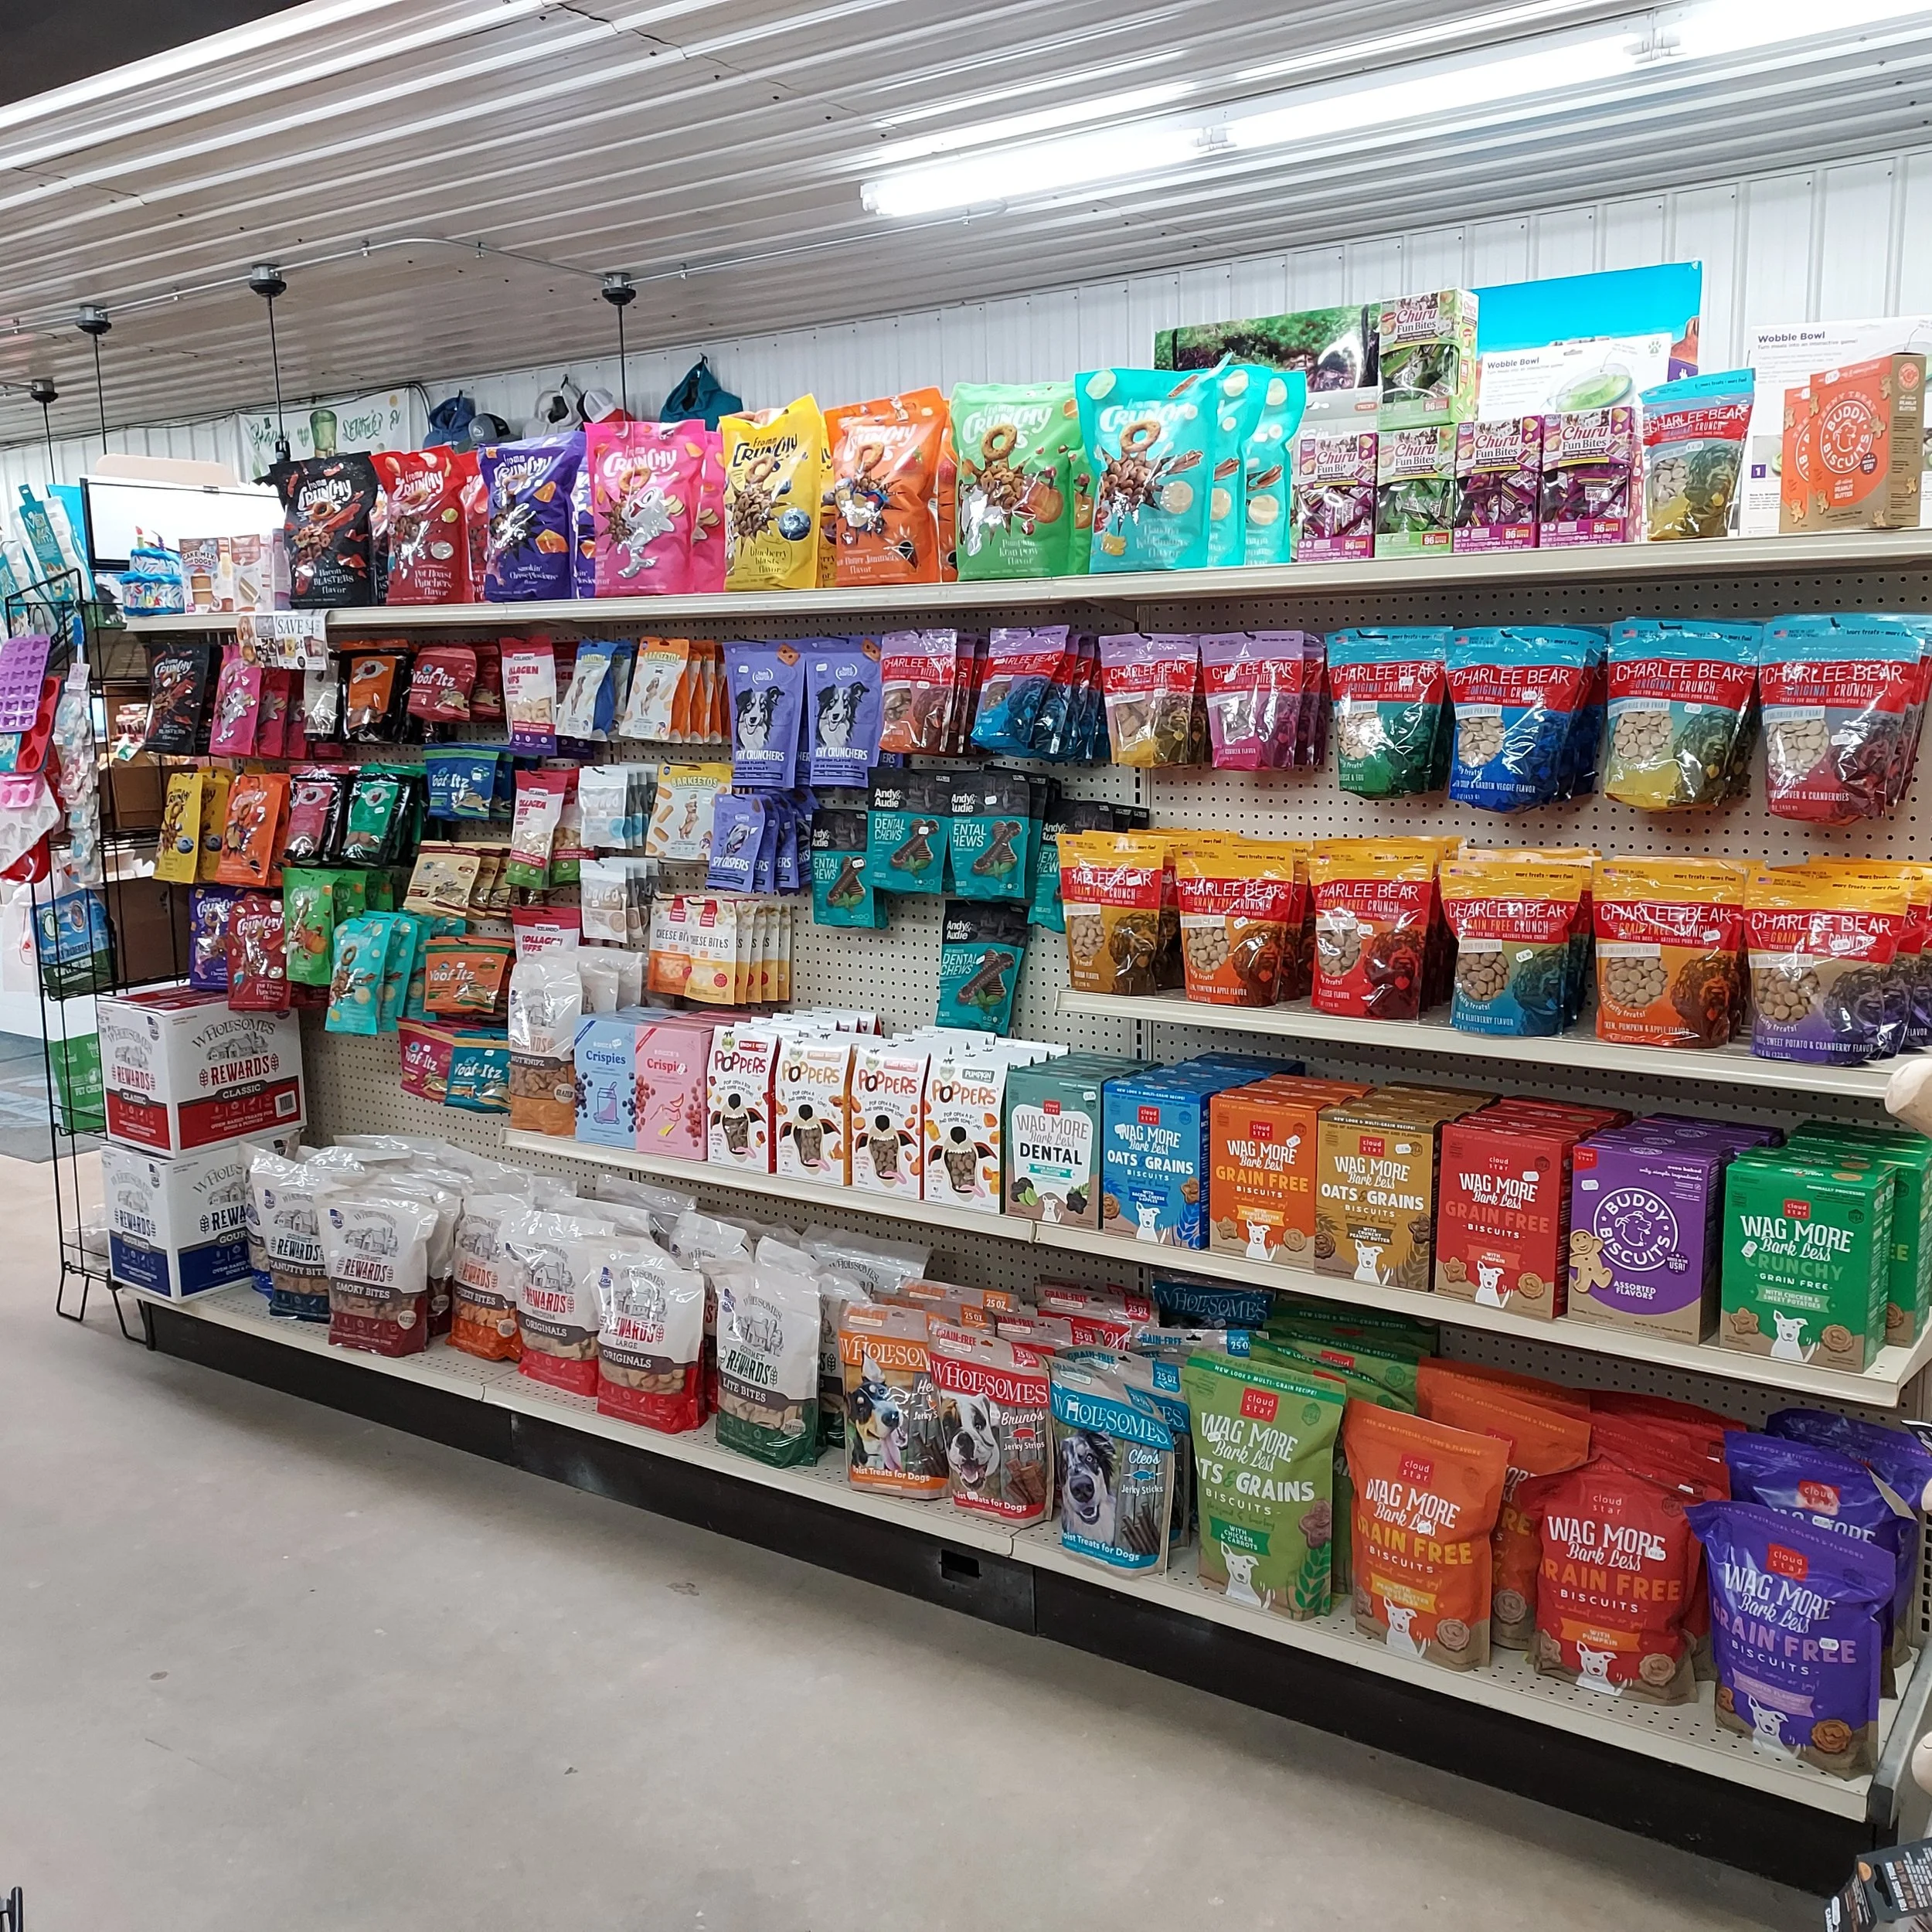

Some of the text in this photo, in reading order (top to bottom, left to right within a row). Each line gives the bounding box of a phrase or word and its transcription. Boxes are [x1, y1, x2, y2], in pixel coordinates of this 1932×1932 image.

[1396, 308, 1437, 324] Churu
[1397, 320, 1436, 333] Fun Bites
[1758, 332, 1825, 342] Wobble Bowl
[1488, 359, 1516, 369] Wobble
[1708, 406, 1745, 421] BEAR
[1828, 406, 1866, 430] BUDDY
[1562, 427, 1607, 440] Churu
[1396, 443, 1437, 457] Churu
[1563, 437, 1607, 448] Fun Bites
[733, 434, 798, 468] CRUNCHY
[1823, 434, 1869, 468] BISCUITS
[1395, 454, 1435, 467] Fun Bites
[1423, 535, 1435, 545] 96
[182, 552, 199, 560] CAKE
[314, 576, 354, 585] BLASTERS
[277, 619, 303, 634] SAVE
[1158, 662, 1186, 675] BEAR
[1616, 662, 1743, 685] CHARLEE BEAR
[1853, 665, 1903, 684] BEAR
[1453, 668, 1569, 687] CHARLEE BEAR
[1471, 685, 1505, 696] ORIGINAL
[1636, 679, 1715, 694] ORIGINAL CRUNCH
[1835, 684, 1873, 697] CRUNCH
[745, 749, 784, 762] CRUNCHERS
[828, 748, 867, 760] CRUNCHERS
[672, 777, 716, 787] BARKEETOS
[1476, 781, 1536, 793] GARDEN VEGGIE FLAVOR
[875, 798, 899, 808] Audie
[1809, 792, 1849, 801] CRANBERRIES
[875, 818, 905, 831] DENTAL
[875, 829, 902, 840] CHEWS
[1377, 883, 1419, 902] BEAR
[1348, 900, 1399, 913] FREE CRUNCH
[1685, 906, 1732, 923] BEAR
[1491, 920, 1549, 934] FREE CRUNCH
[1841, 915, 1892, 936] BEAR
[708, 936, 729, 949] BITES
[947, 930, 968, 940] Audie
[1770, 932, 1796, 944] GRAIN
[942, 954, 977, 966] DENTAL
[940, 964, 973, 975] CHEWS
[1495, 1017, 1513, 1026] FLAVOR
[1767, 1038, 1874, 1053] SWEET POTATO & CRANBERRY FLAVOR
[586, 1050, 626, 1065] Crispies
[715, 1052, 767, 1073] POPPERS
[117, 1066, 150, 1090] REWARDS
[210, 1056, 270, 1085] REWARDS
[782, 1062, 840, 1083] POPPERS
[859, 1069, 919, 1094] POPPERS
[123, 1092, 146, 1104] CLASSIC
[223, 1083, 260, 1099] CLASSIC
[933, 1080, 996, 1104] POPPERS
[1016, 1114, 1088, 1141] WAG MORE
[1029, 1132, 1075, 1148] Bark Less
[1147, 1128, 1181, 1148] MORE
[1020, 1144, 1082, 1164] DENTAL
[1129, 1139, 1169, 1155] Bark Less
[1227, 1140, 1297, 1165] WAG MORE
[1107, 1150, 1194, 1175] OATS GRAINS
[1240, 1155, 1283, 1171] Bark Less
[1334, 1156, 1410, 1182] WAG MORE
[1127, 1170, 1169, 1181] BISCUITS
[1216, 1165, 1308, 1192] GRAIN FREE
[1236, 1185, 1283, 1198] BISCUITS
[1459, 1173, 1539, 1202] WAG MORE
[1321, 1184, 1423, 1211] OATS GRAINS
[1345, 1206, 1396, 1217] BISCUITS
[1605, 1192, 1668, 1223] BUDDY
[1445, 1202, 1549, 1233] GRAIN FREE
[1468, 1226, 1519, 1239] BISCUITS
[1741, 1216, 1854, 1253] WAG MORE
[1600, 1227, 1670, 1265] BISCUITS
[1760, 1239, 1831, 1261] Bark Less
[345, 1259, 388, 1282] REWARDS
[1669, 1262, 1685, 1270] USA!
[1614, 1281, 1656, 1294] ASSORTED
[1760, 1274, 1829, 1290] GRAIN FREE
[336, 1284, 389, 1298] SMOKY BITES
[1615, 1289, 1653, 1301] FLAVORS
[526, 1319, 566, 1337] ORIGINALS
[615, 1339, 638, 1349] LARGE
[604, 1349, 651, 1368] ORIGINALS
[723, 1376, 765, 1402] LITE BITES
[931, 1361, 1048, 1403] WHOLESOMES
[1247, 1395, 1274, 1407] cloud
[1002, 1411, 1045, 1425] Bruno's
[1053, 1394, 1169, 1444] WHOLESOMES
[1246, 1406, 1271, 1416] star
[1024, 1440, 1045, 1450] Strips
[1250, 1423, 1298, 1462] MORE
[1128, 1450, 1161, 1464] Cleo's
[1121, 1485, 1140, 1494] Jerky
[1237, 1473, 1314, 1502] GRAINS
[1206, 1488, 1271, 1515] BISCUITS
[1366, 1479, 1461, 1529] WAG MORE
[1224, 1529, 1253, 1543] CHICKEN
[1547, 1515, 1595, 1544] WAG
[1077, 1535, 1139, 1561] Treats for Dogs
[1413, 1537, 1472, 1564] FREE
[1566, 1542, 1641, 1570] Bark Less
[1369, 1546, 1433, 1573] BISCUITS
[1617, 1576, 1681, 1601] FREE
[1724, 1564, 1835, 1621] WAG MORE
[1560, 1590, 1638, 1612] BISCUITS
[1739, 1594, 1810, 1634] Bark Less
[1785, 1633, 1856, 1663] FREE
[1733, 1641, 1808, 1675] BISCUITS
